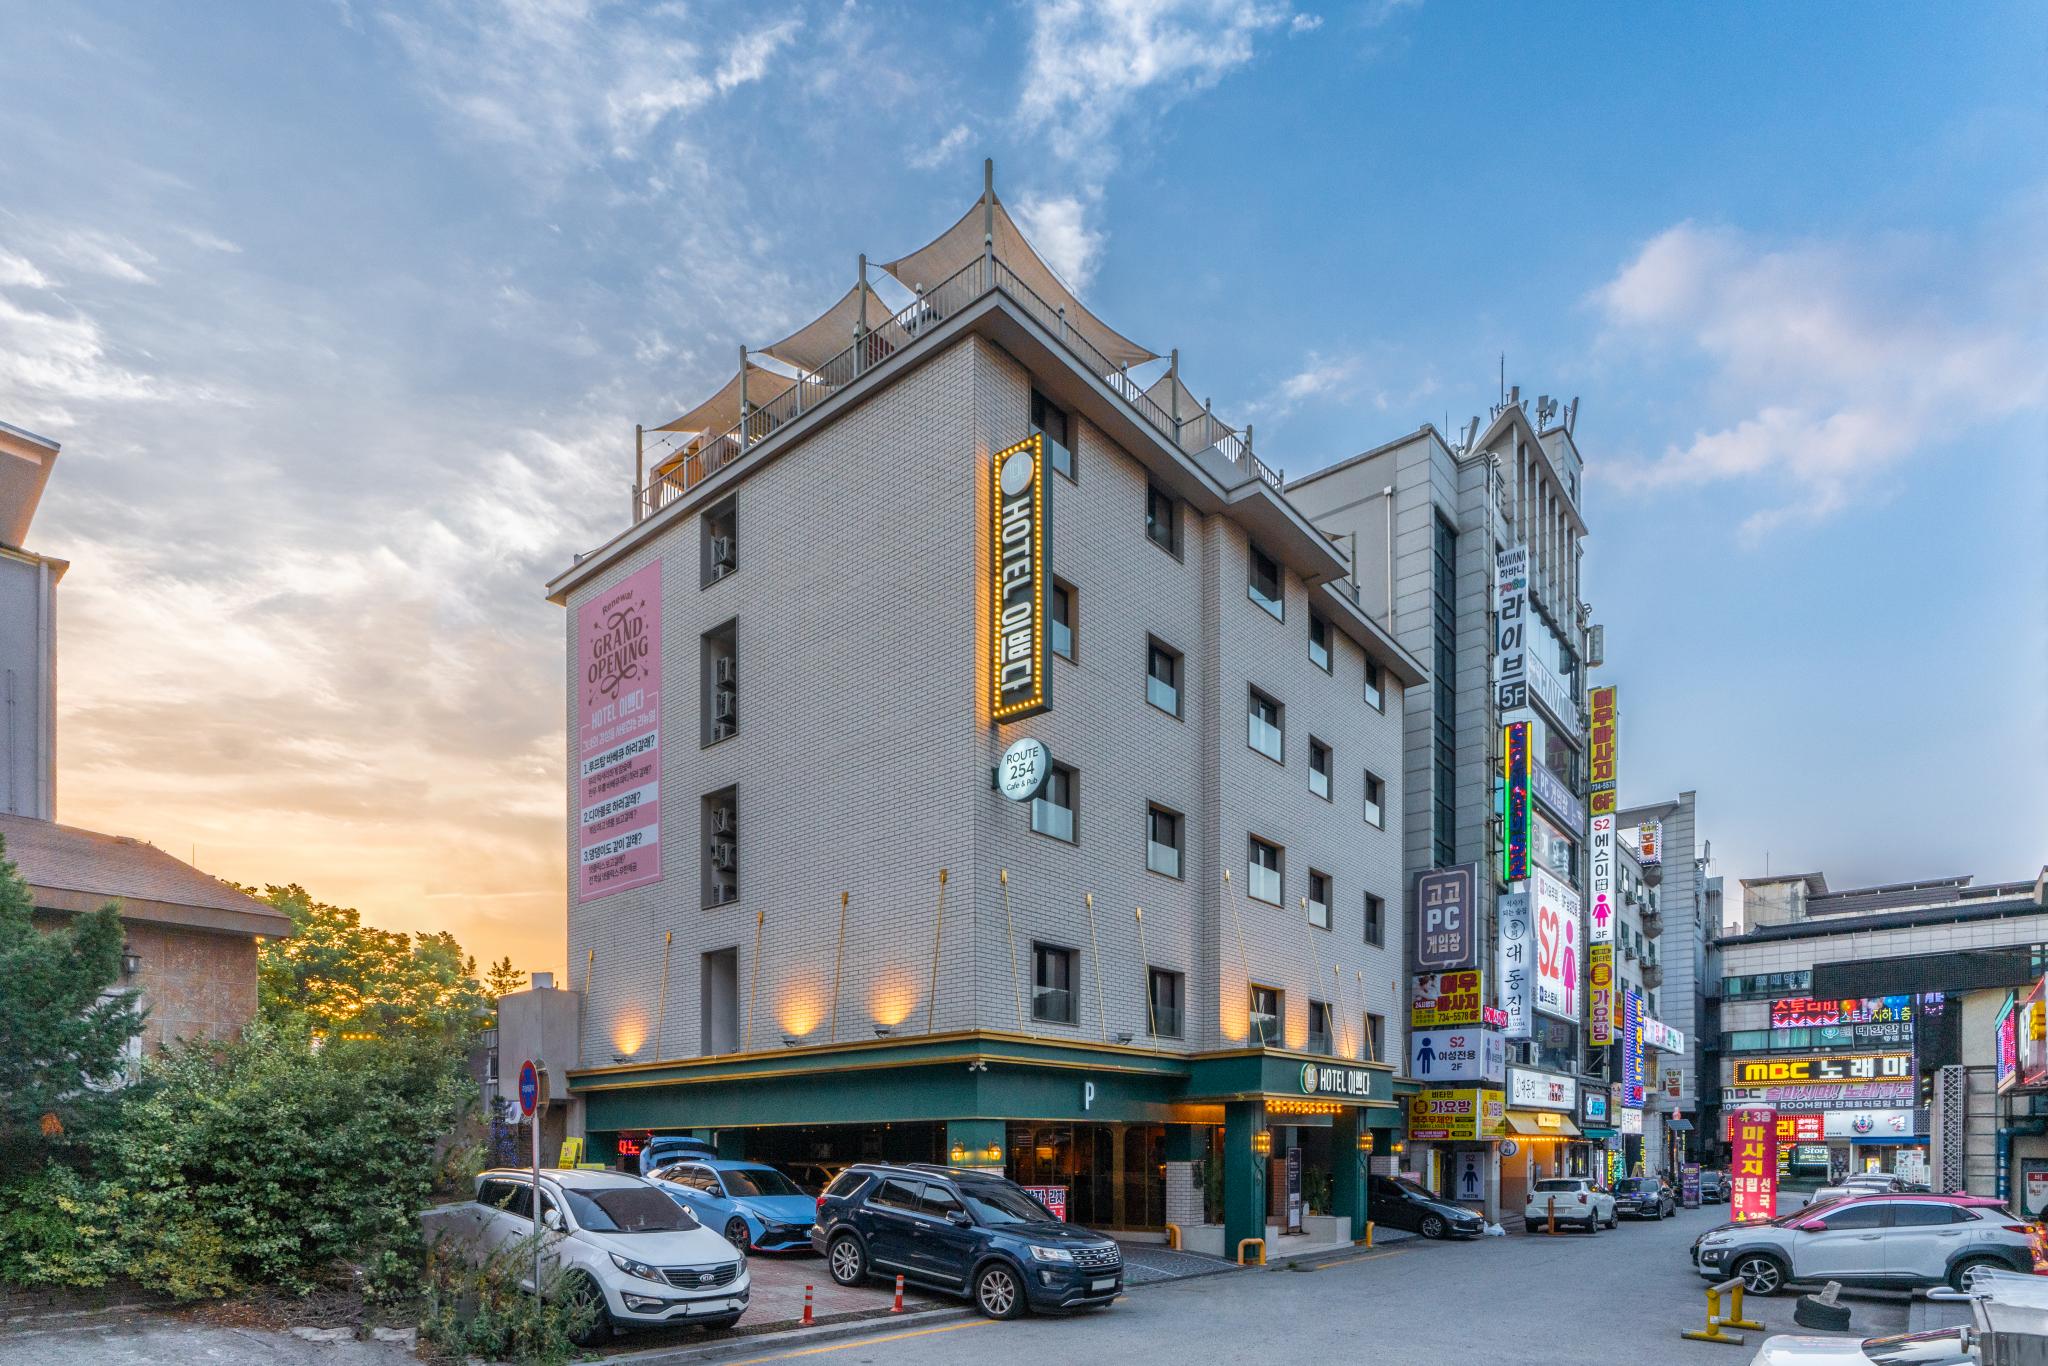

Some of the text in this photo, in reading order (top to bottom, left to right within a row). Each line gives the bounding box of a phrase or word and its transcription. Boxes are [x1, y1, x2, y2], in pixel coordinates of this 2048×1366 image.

[1500, 550, 1526, 568] HAVANA
[1500, 564, 1526, 579] 하바나
[602, 590, 633, 615] Renewal
[1000, 496, 1033, 692] HOTEL 이쁘다
[594, 614, 642, 659] GRAND
[1501, 593, 1524, 680] 라이브
[588, 635, 648, 683] OPENING
[1501, 685, 1525, 708] 5F
[592, 704, 616, 730] HOTEL
[1593, 688, 1614, 781] 여우마사지
[1007, 746, 1039, 765] ROUTE
[1010, 760, 1034, 781] 254
[1007, 782, 1020, 791] Cafe
[1027, 778, 1038, 786] Pub
[1594, 818, 1610, 831] S2
[1427, 881, 1460, 907] 고고
[1427, 906, 1460, 932] PC
[1427, 932, 1460, 954] 게임장
[1539, 905, 1559, 980] S2
[1596, 930, 1607, 939] 3F
[1592, 953, 1611, 963] 비타민
[1440, 973, 1478, 994] 여우
[1504, 943, 1524, 1016] 대동집
[1437, 993, 1479, 1012] 마사지
[1439, 1012, 1469, 1022] 734-5578
[1592, 988, 1610, 1042] 가요방
[1449, 1036, 1465, 1048] S2
[1439, 1050, 1476, 1061] 여성전용
[1451, 1063, 1463, 1071] 2F
[1746, 1062, 1809, 1081] MBC
[1320, 1068, 1370, 1095] HOTEL 이쁘다
[1084, 1081, 1095, 1110] P
[1432, 1090, 1454, 1099] 비타민
[1722, 1088, 1761, 1100] MBC
[1430, 1100, 1472, 1114] 가요방
[1754, 1111, 1771, 1123] 3층
[1741, 1125, 1766, 1175] 마사지
[1048, 1189, 1065, 1205] 감자
